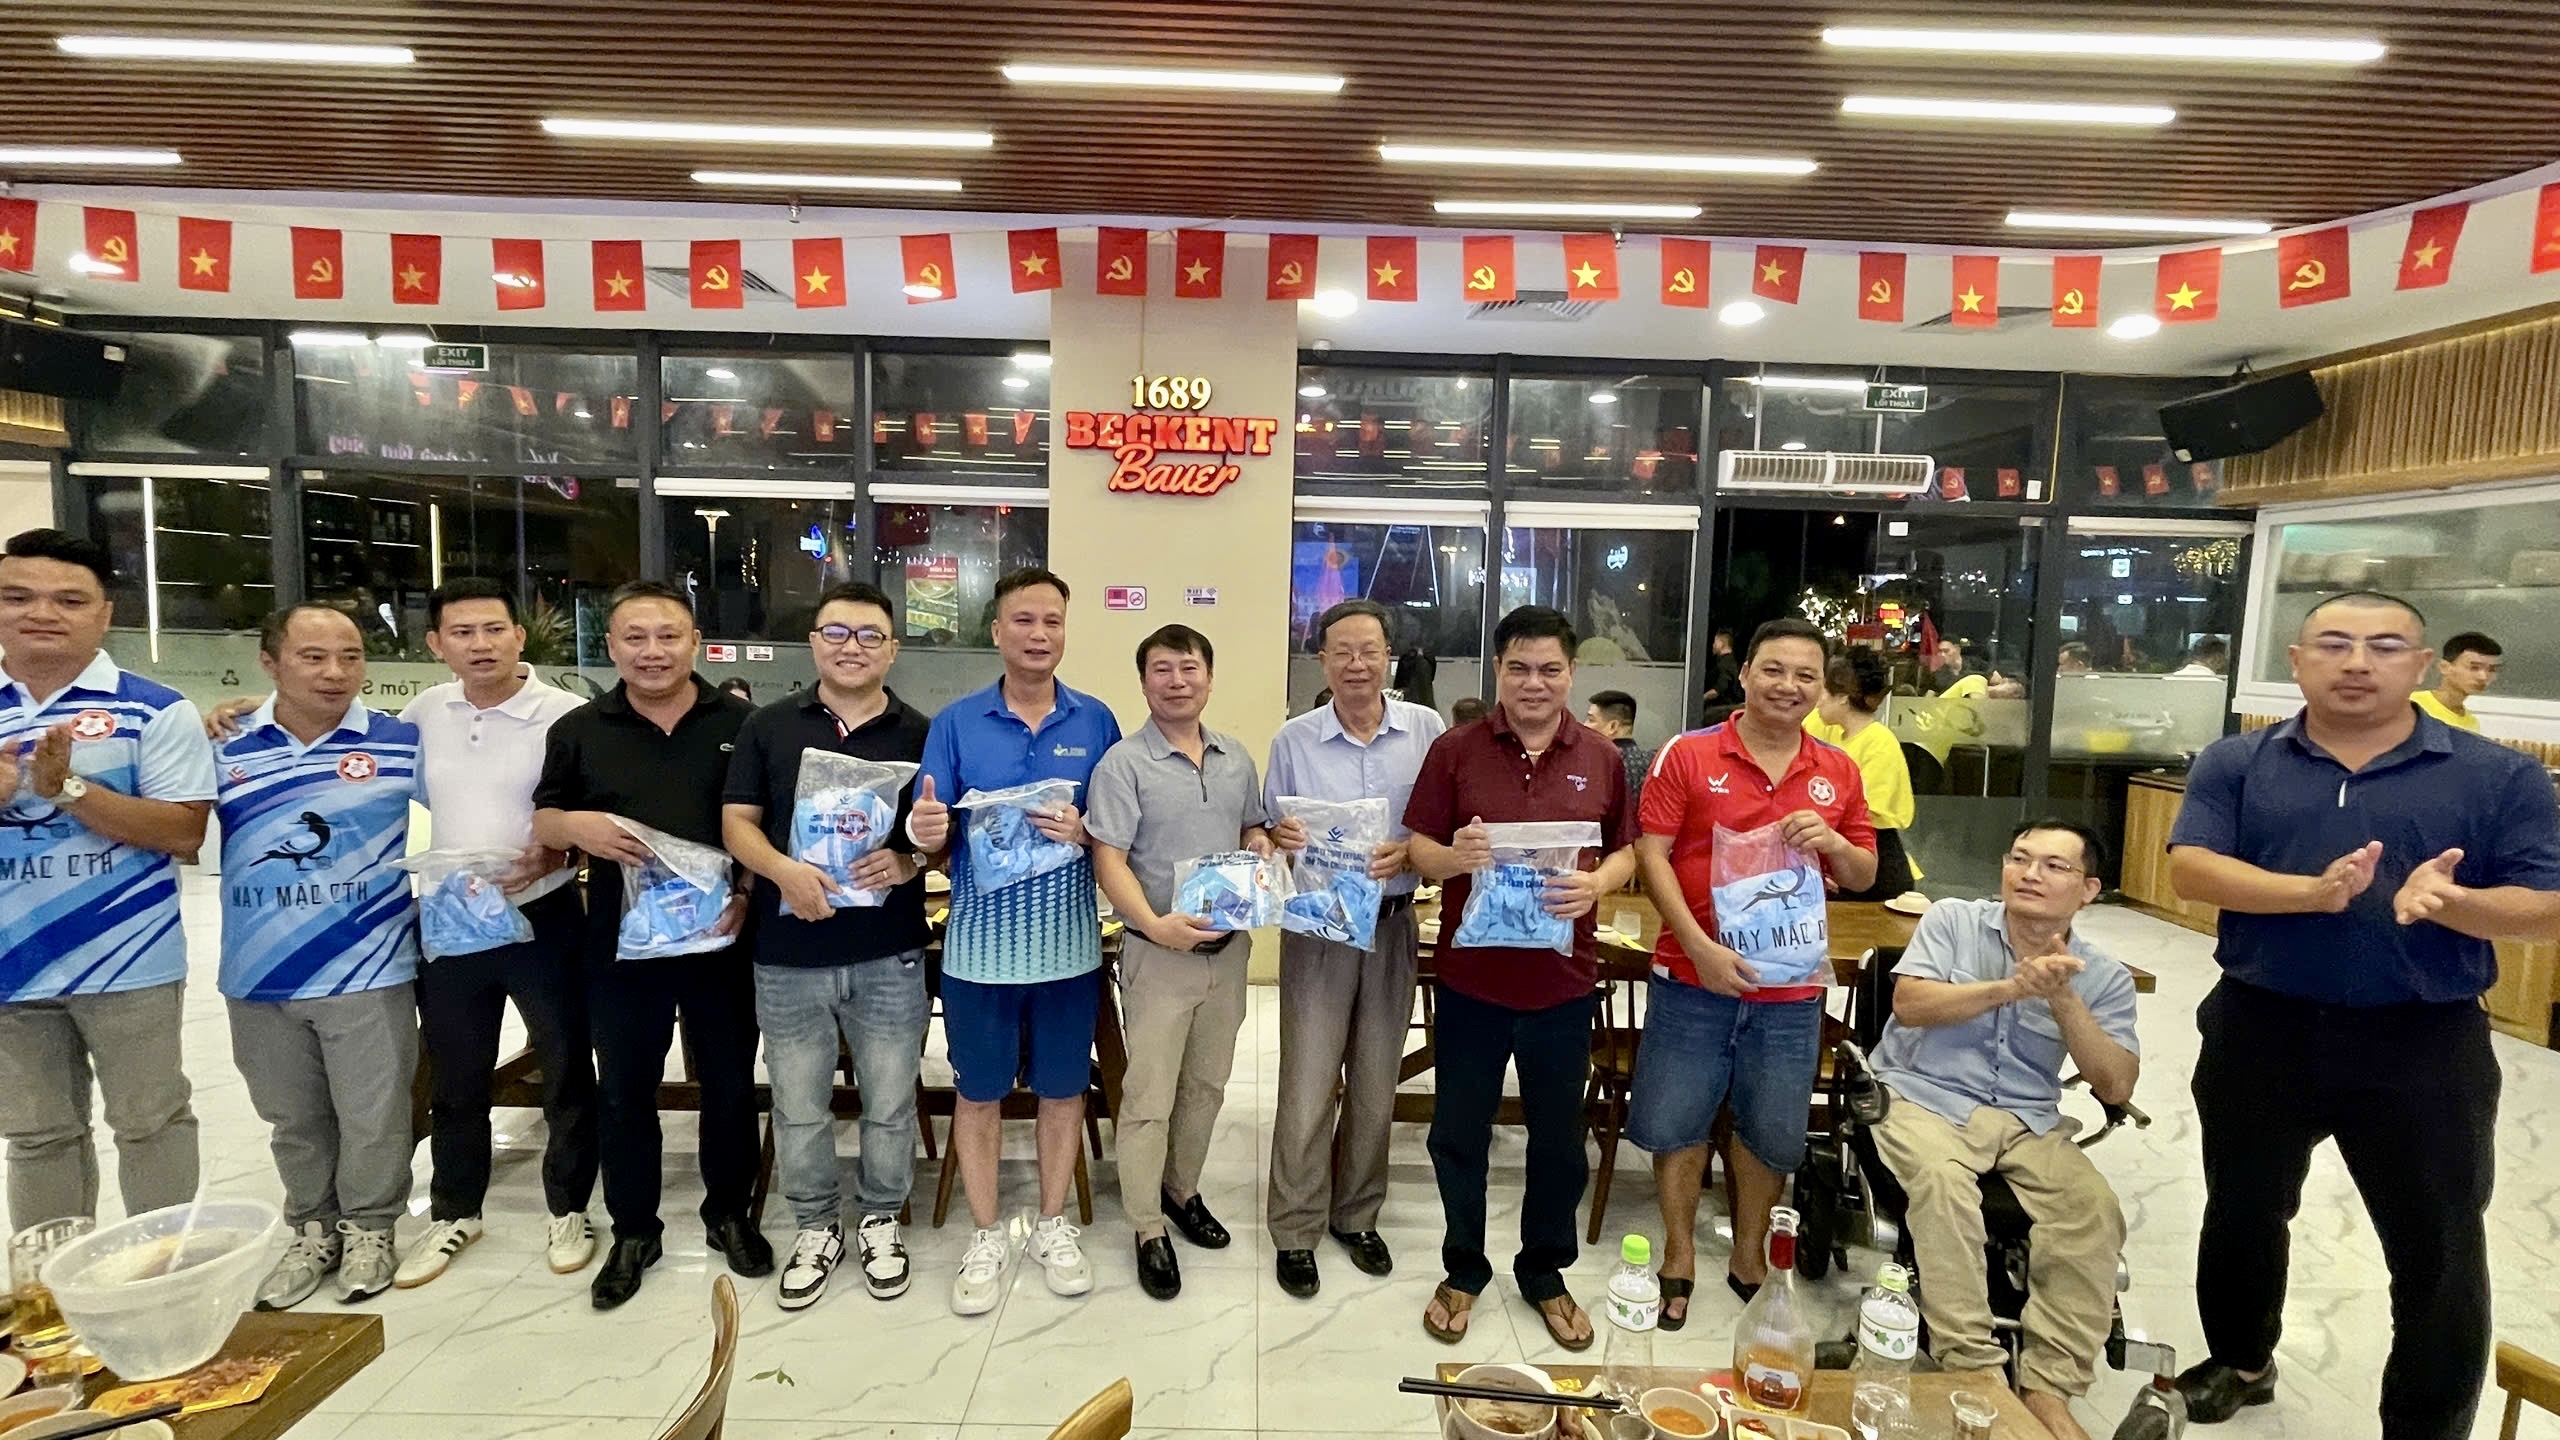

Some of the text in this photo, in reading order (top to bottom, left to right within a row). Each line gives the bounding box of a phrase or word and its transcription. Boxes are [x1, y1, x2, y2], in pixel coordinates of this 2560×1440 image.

[438, 348, 468, 357] EXIT
[1132, 375, 1213, 410] 1689
[1881, 389, 1909, 398] EXIT
[1066, 411, 1278, 456] BECKENT
[1108, 442, 1241, 496] Bauer
[67, 850, 113, 877] CTH
[330, 881, 368, 903] CTH
[1720, 928, 1760, 952] MAY
